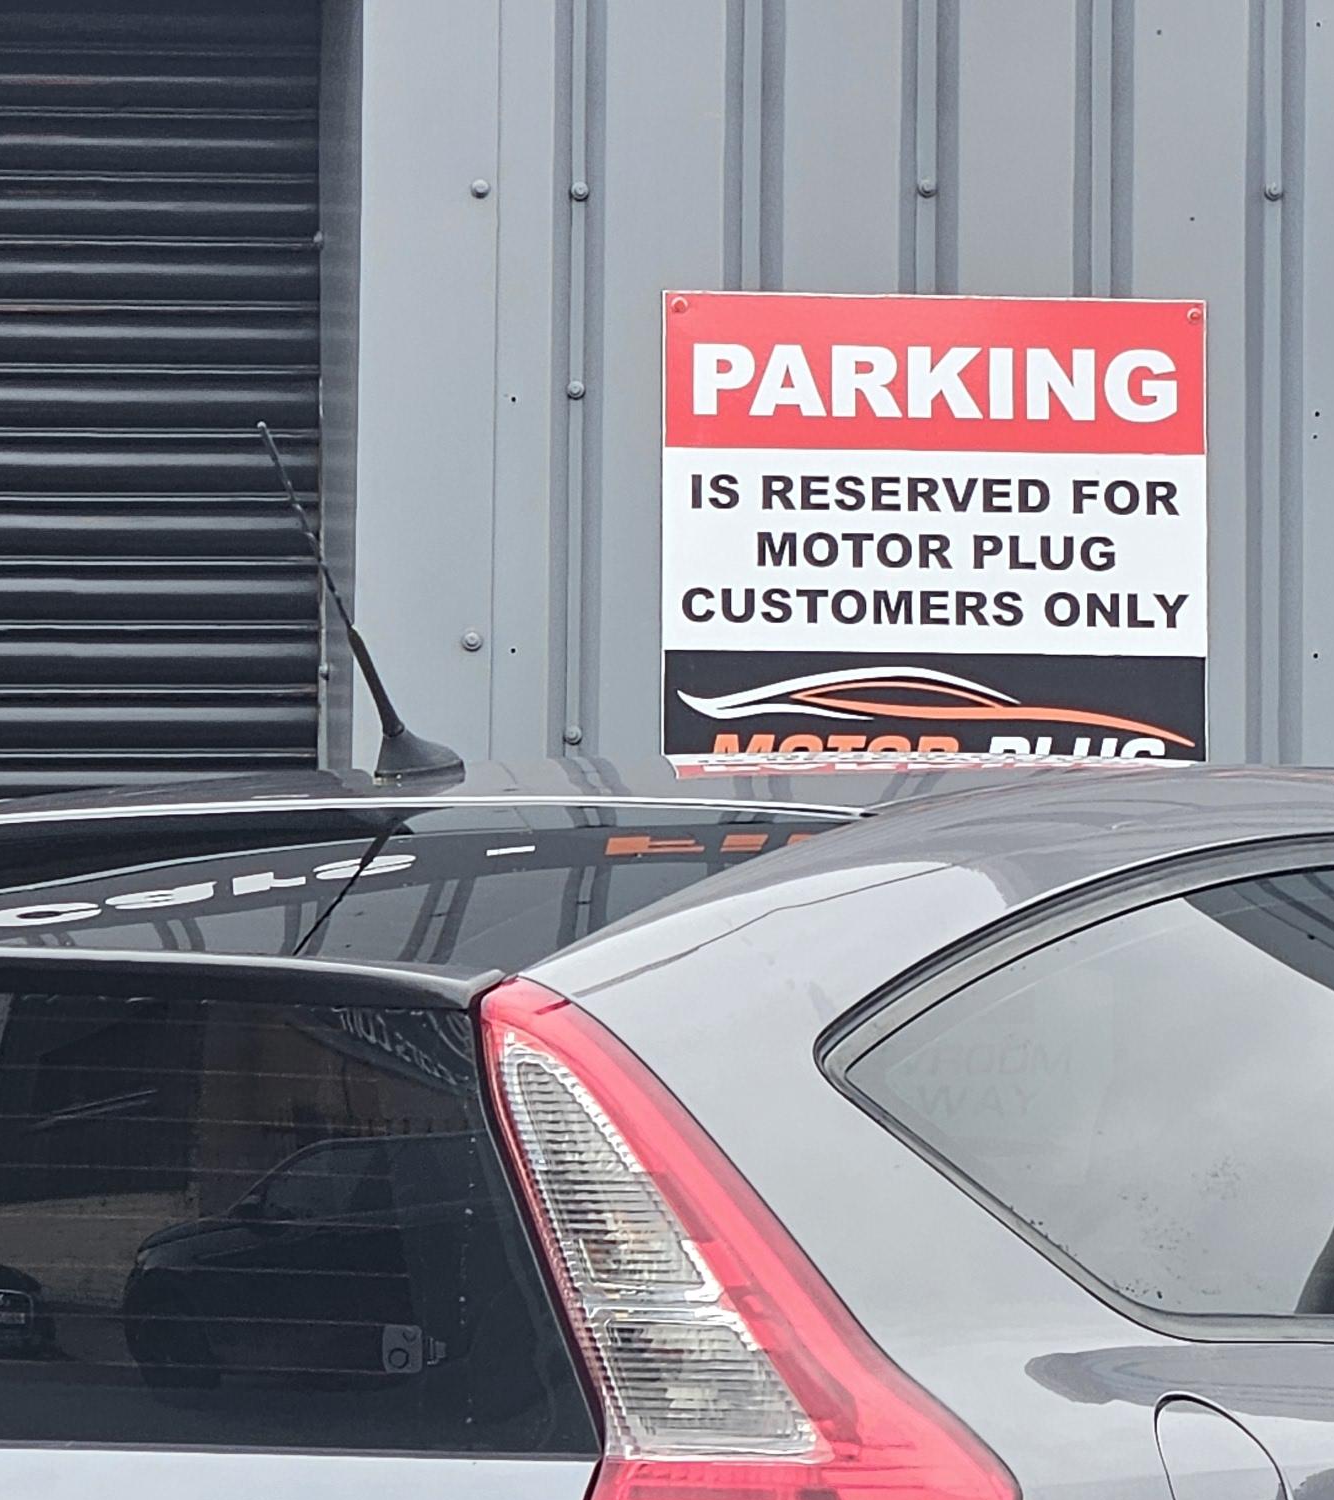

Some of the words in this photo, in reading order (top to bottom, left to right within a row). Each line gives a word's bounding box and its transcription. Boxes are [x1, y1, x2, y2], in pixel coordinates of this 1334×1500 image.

[692, 343, 1178, 423] PARKING
[690, 474, 740, 510] IS
[761, 475, 1051, 514] RESERVED
[1072, 480, 1180, 516] FOR
[756, 532, 953, 569] MOTOR
[972, 535, 1117, 572] PLUG
[681, 588, 1024, 627] CUSTOMERS
[1044, 592, 1189, 629] ONLY
